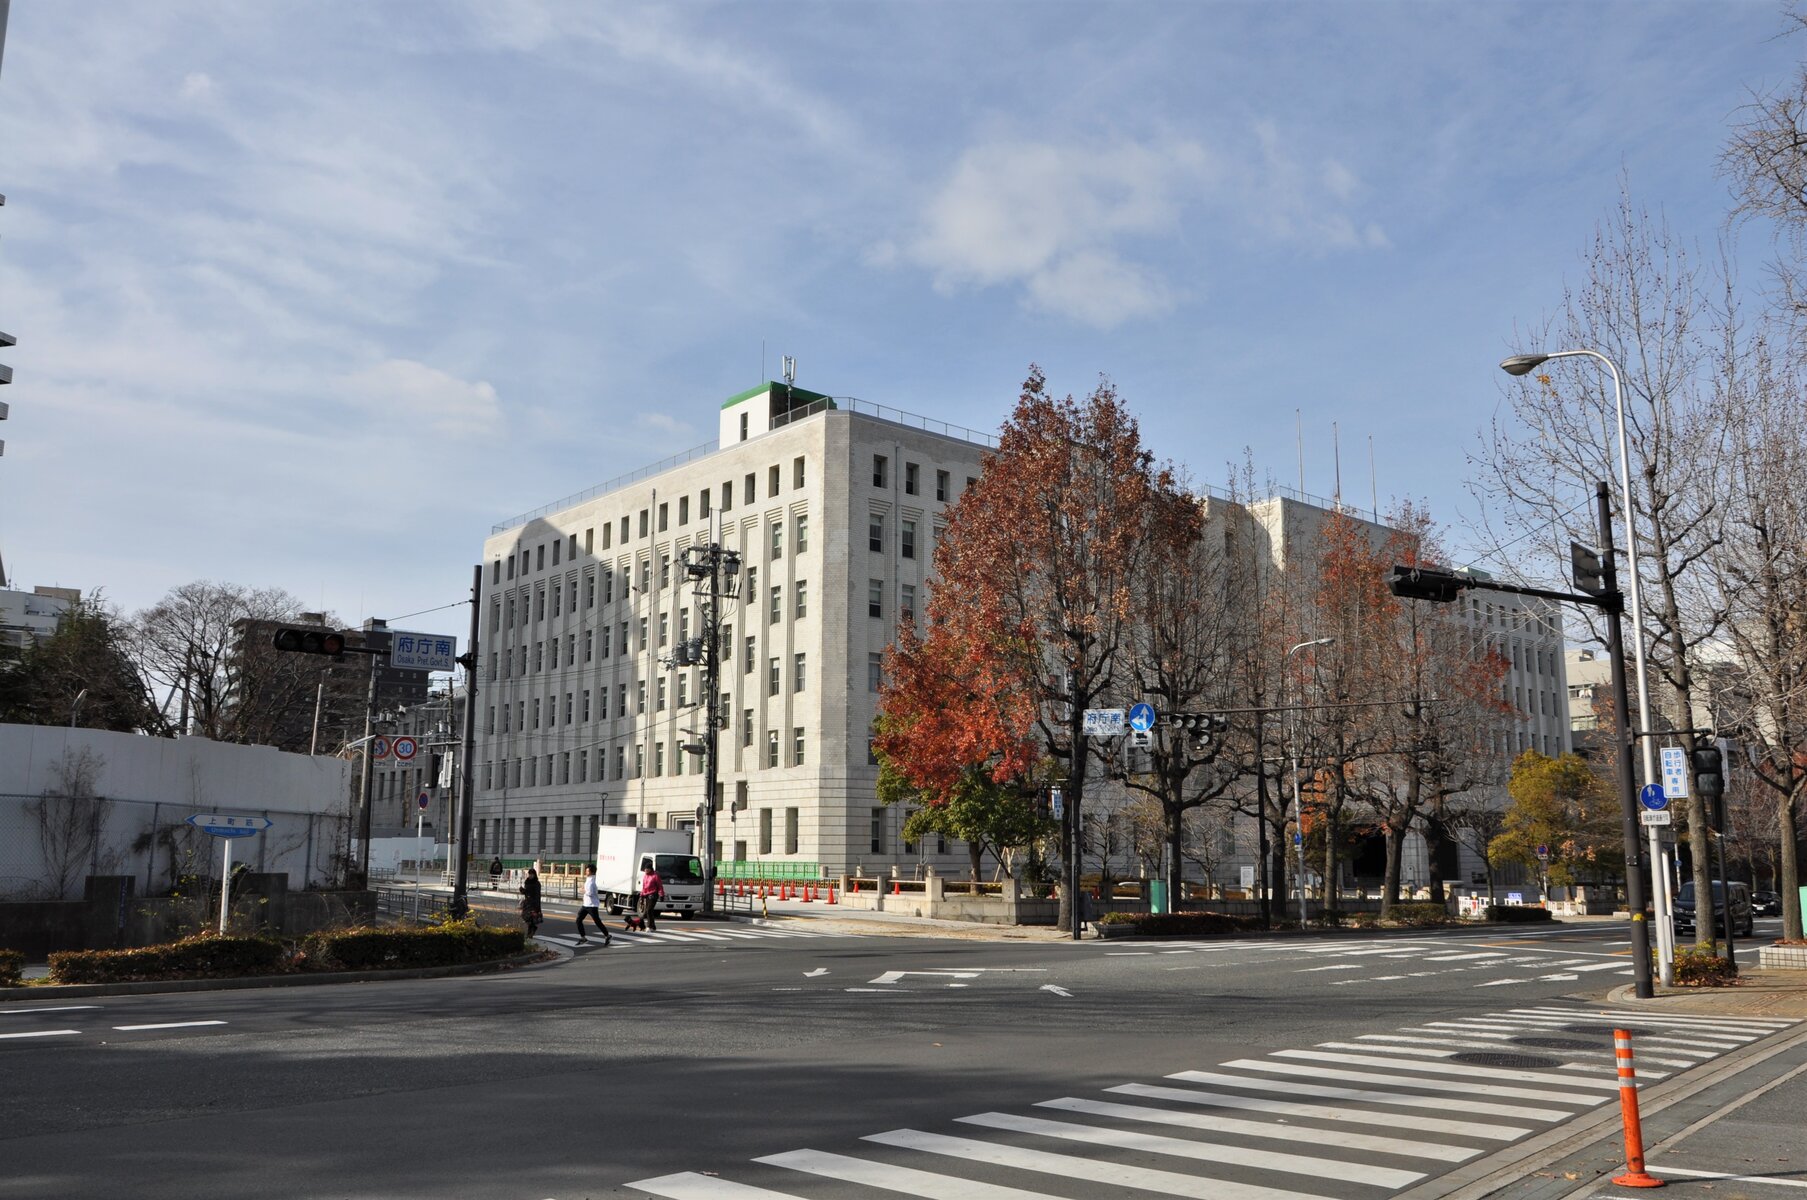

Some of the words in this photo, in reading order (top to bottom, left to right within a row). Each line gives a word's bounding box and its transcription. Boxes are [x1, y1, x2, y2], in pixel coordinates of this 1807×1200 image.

[397, 636, 451, 656] 府庁南
[397, 654, 414, 665] Osaka
[1087, 713, 1121, 725] 府庁南
[399, 743, 412, 754] 30
[1664, 752, 1673, 775] 自転車
[1674, 752, 1682, 775] 歩行者
[1672, 778, 1680, 794] 専用
